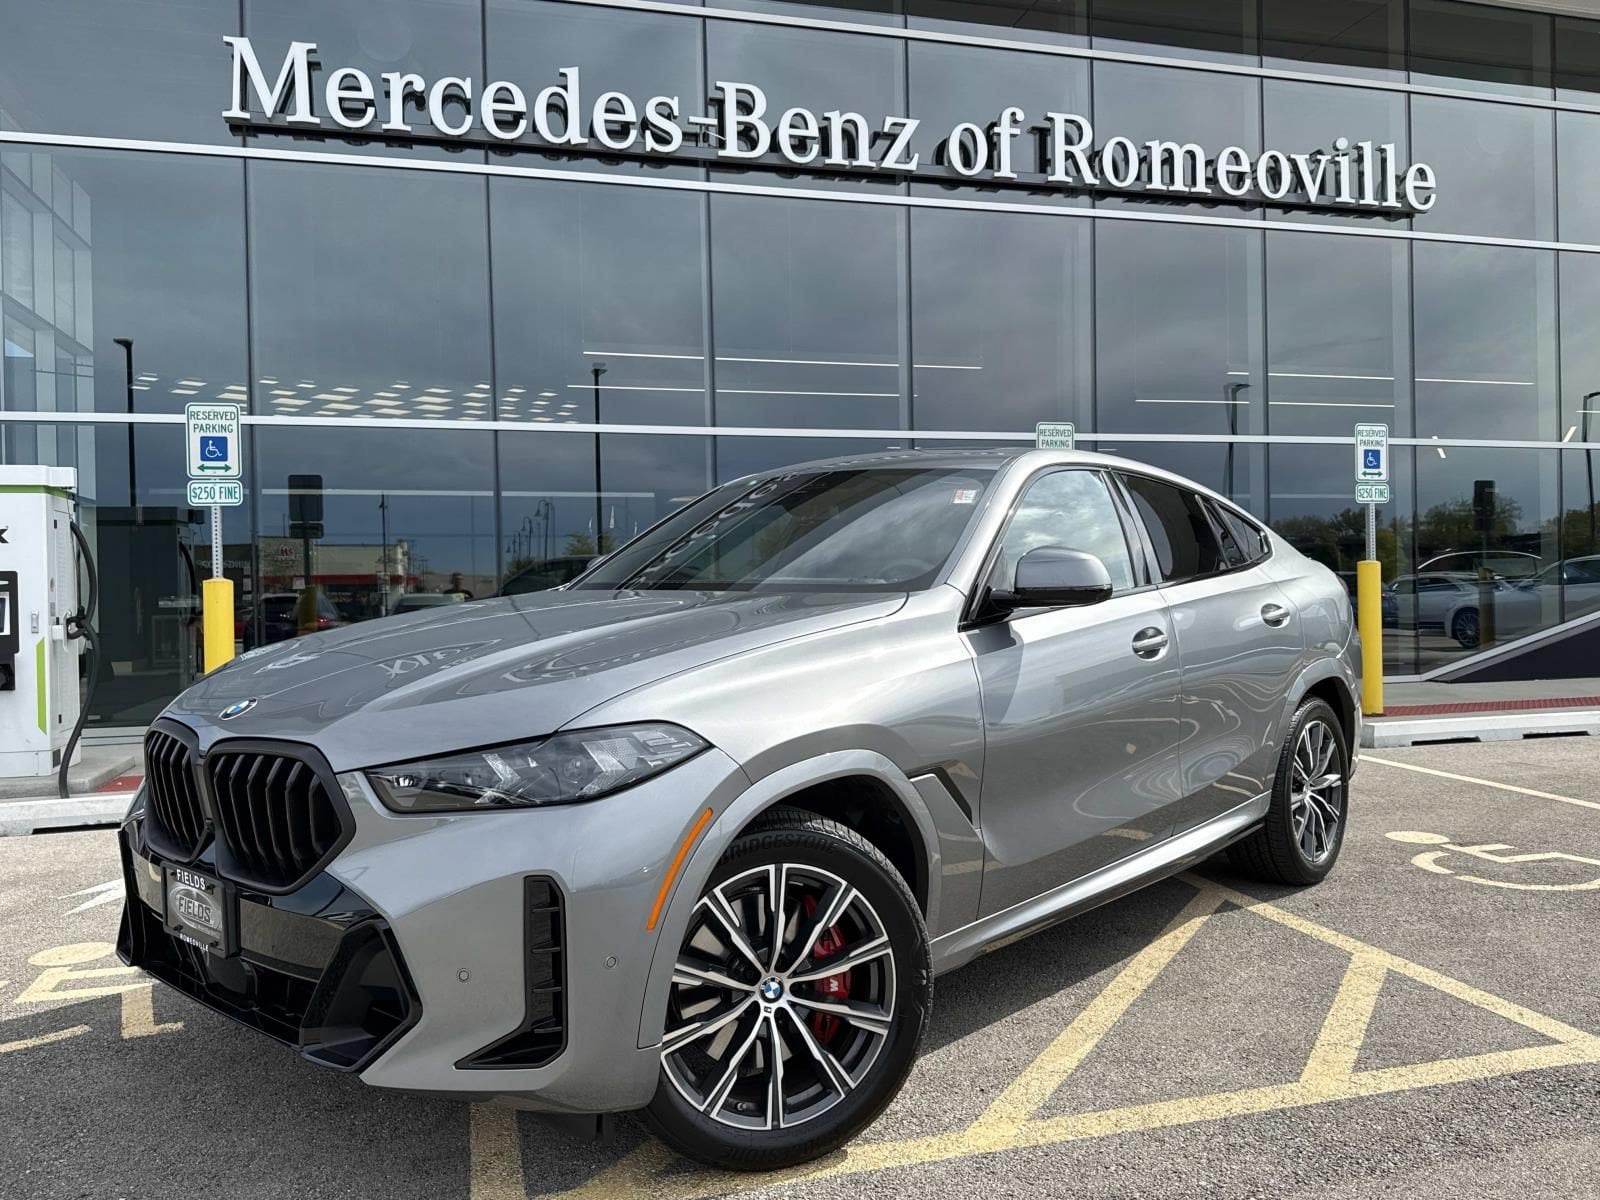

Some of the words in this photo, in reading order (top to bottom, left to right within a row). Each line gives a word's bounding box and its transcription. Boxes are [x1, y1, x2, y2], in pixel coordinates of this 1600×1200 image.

[222, 35, 920, 171] Mercedes-Benz
[948, 107, 1025, 179] of
[1046, 111, 1438, 212] Romeoville
[190, 411, 236, 420] RESERVED
[193, 424, 234, 433] PARKING
[1040, 429, 1071, 437] RESERVED
[1041, 440, 1070, 448] PARKING
[192, 486, 216, 500] $250
[219, 486, 239, 500] FINE
[1358, 488, 1373, 499] $250
[1374, 488, 1387, 499] FINE
[176, 868, 206, 891] FIELDS
[178, 895, 212, 924] FIELDS
